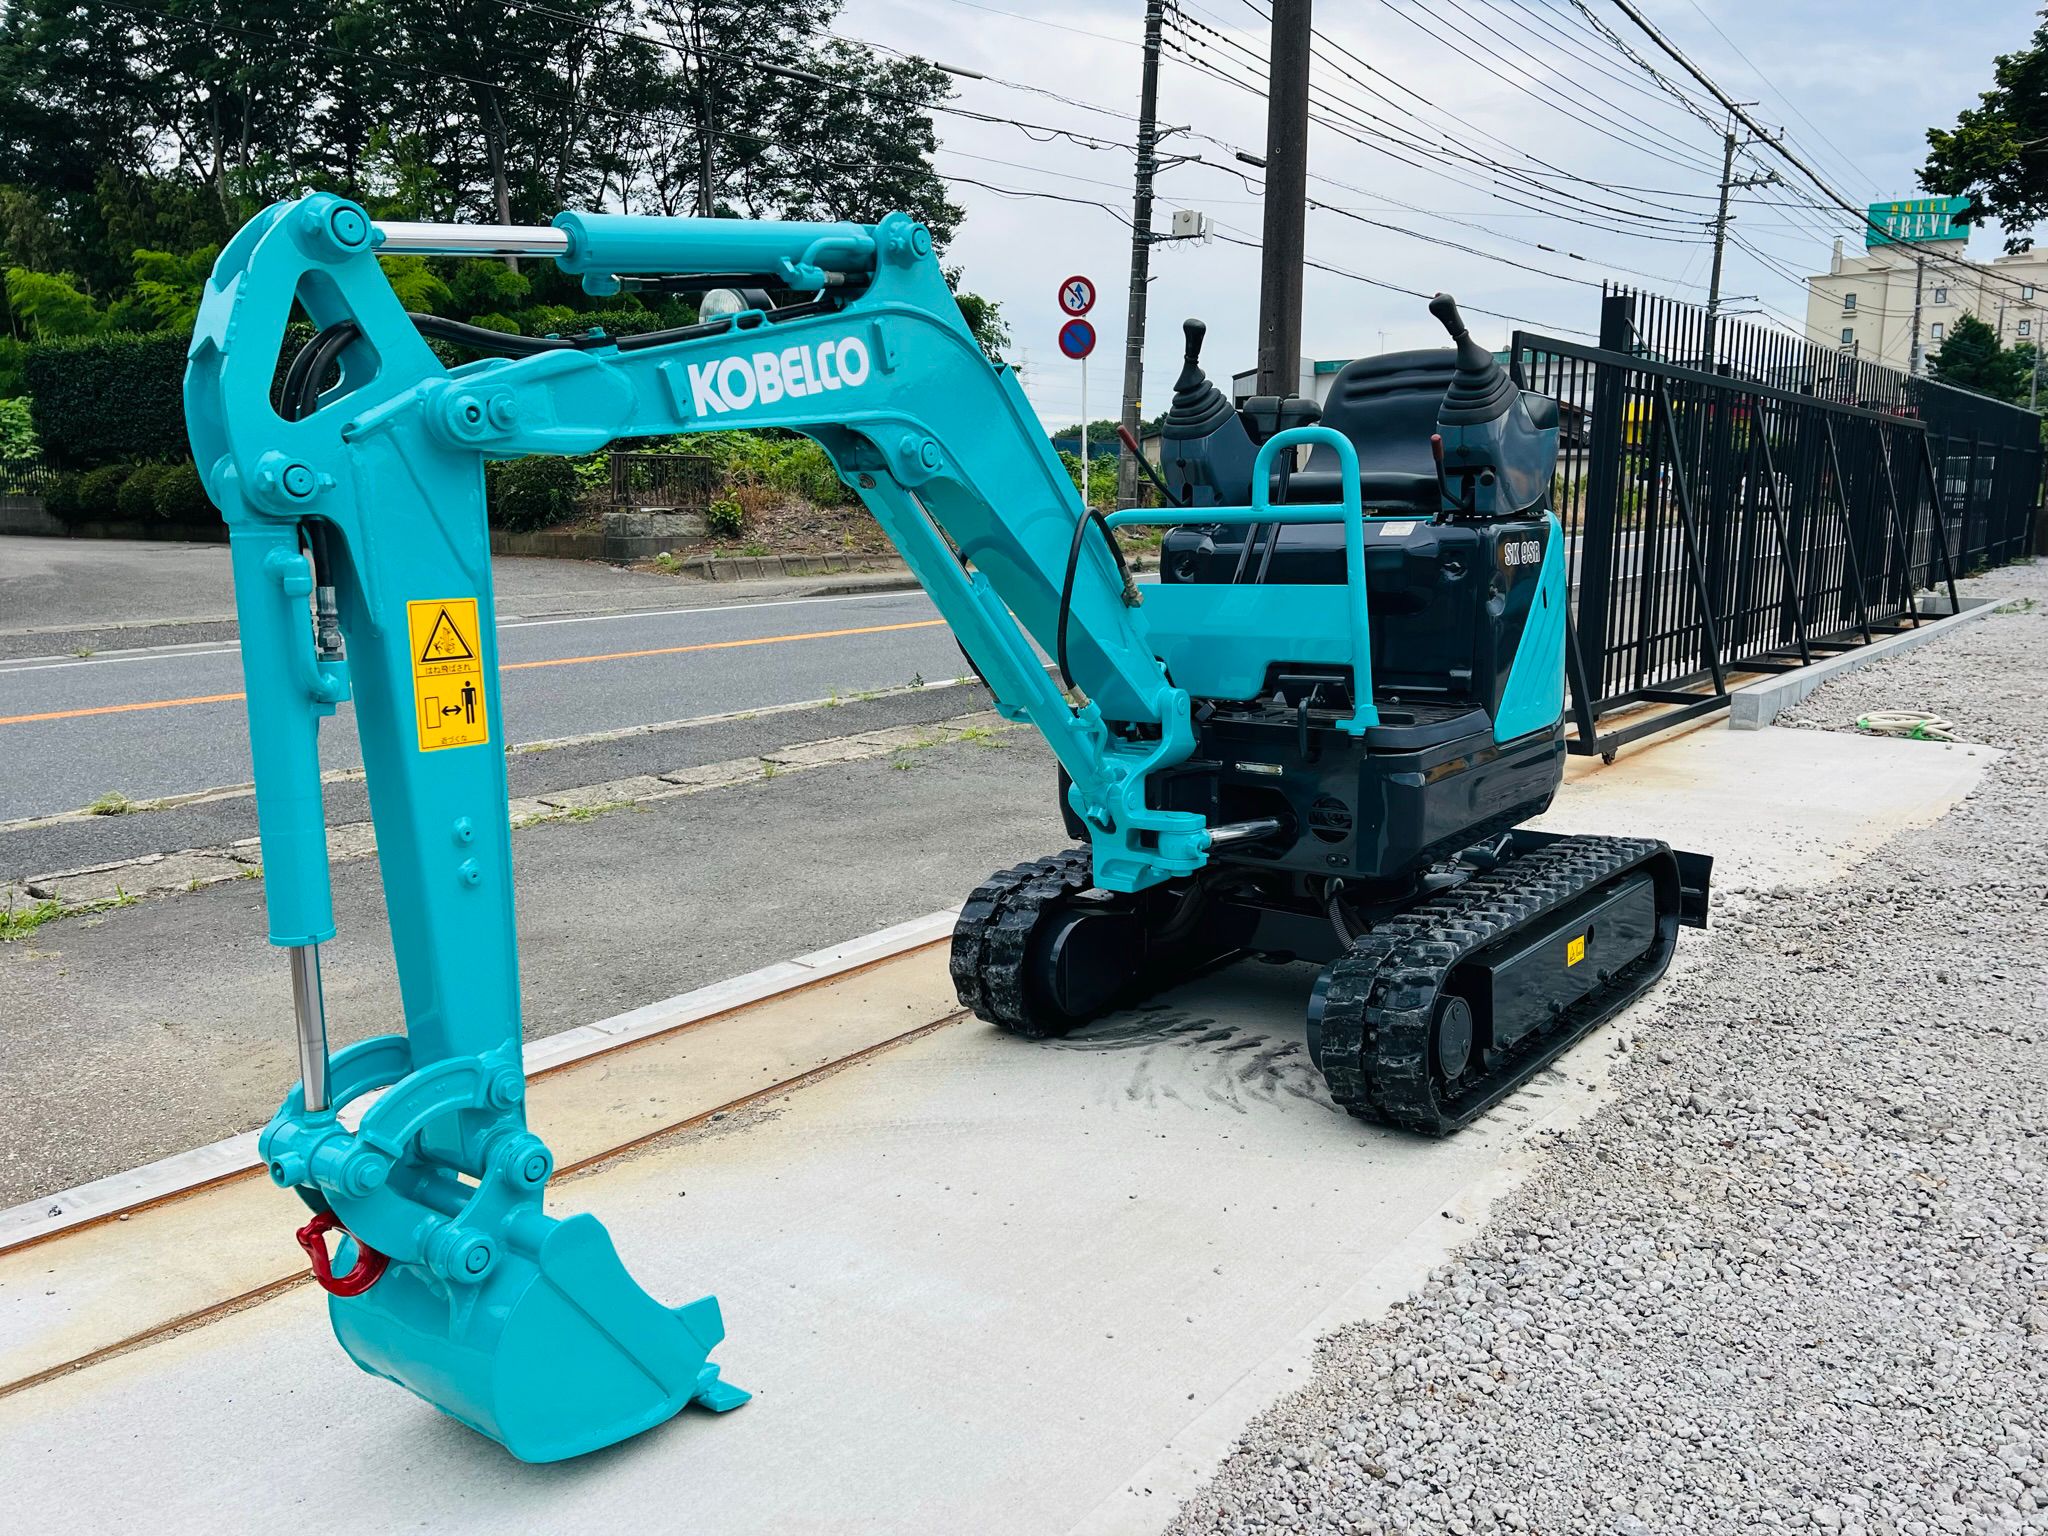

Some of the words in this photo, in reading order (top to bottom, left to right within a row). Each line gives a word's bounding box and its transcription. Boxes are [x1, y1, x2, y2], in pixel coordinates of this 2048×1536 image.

[1886, 214, 1950, 238] TREVI
[688, 336, 869, 417] KOBELCO
[1505, 542, 1519, 566] SK
[1521, 541, 1540, 564] 9SR
